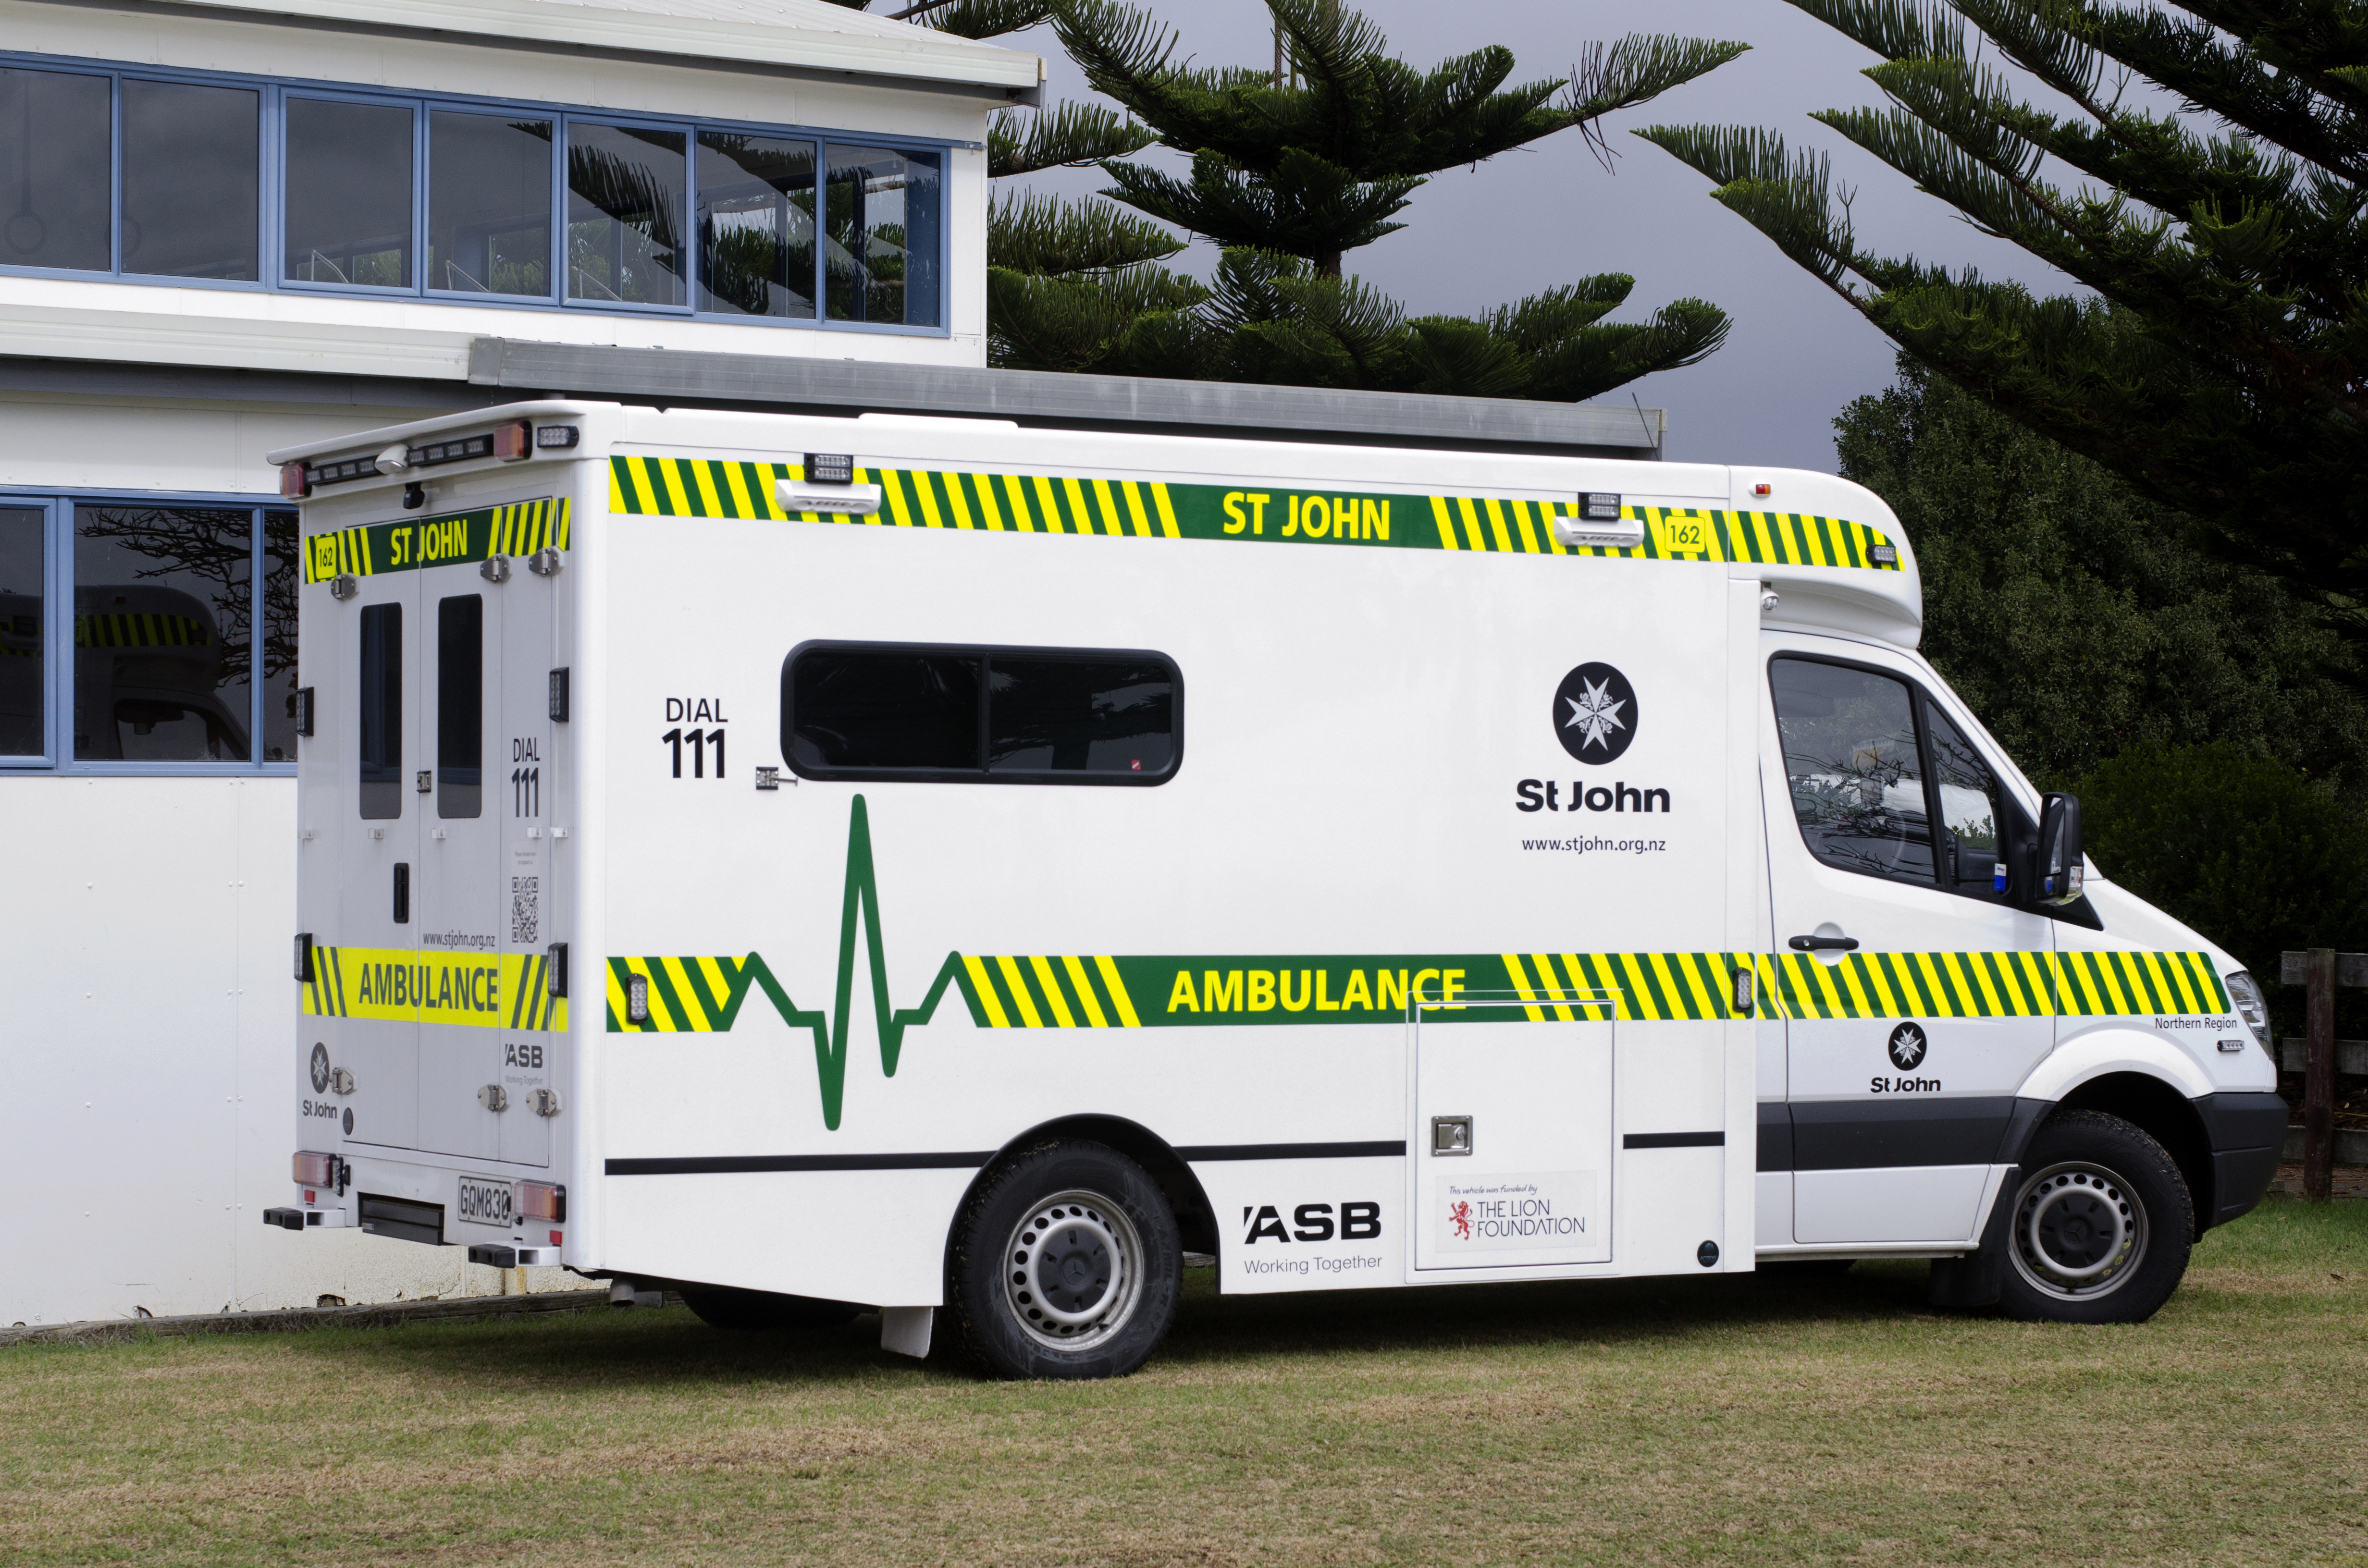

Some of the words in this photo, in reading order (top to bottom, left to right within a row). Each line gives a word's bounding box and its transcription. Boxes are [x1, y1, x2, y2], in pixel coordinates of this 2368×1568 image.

[1223, 491, 1270, 535] ST
[1282, 495, 1390, 540] JOHN
[391, 527, 412, 565] ST
[417, 519, 467, 562] JOHN
[1670, 525, 1700, 544] 162
[319, 547, 333, 567] 162
[666, 698, 728, 723] DIAL
[513, 737, 540, 762] DIAL
[662, 728, 725, 779] 111
[511, 767, 539, 818] 111
[1516, 779, 1558, 812] St
[1567, 781, 1670, 813] John
[1522, 835, 1665, 855] www.stjohn.org.nz
[423, 930, 495, 950] www.stjohn.org.nz
[358, 963, 498, 1012] AMBULANCE
[1167, 968, 1467, 1013] AMBULANCE
[2155, 1017, 2201, 1029] Northern
[2205, 1017, 2237, 1031] Region
[505, 1043, 543, 1068] ASB
[1870, 1077, 1890, 1093] St
[1894, 1077, 1941, 1092] John
[303, 1099, 312, 1116] St
[313, 1101, 337, 1119] John
[1449, 1186, 1461, 1195] This
[1462, 1185, 1485, 1194] vehicle
[1500, 1184, 1527, 1193] funded
[1528, 1184, 1538, 1195] by
[461, 1184, 509, 1221] GQM830
[1477, 1200, 1506, 1218] THE
[1511, 1199, 1550, 1217] LION
[1244, 1201, 1381, 1245] ASB
[1477, 1216, 1585, 1237] FOUNDATION
[1244, 1258, 1308, 1274] Working
[1313, 1254, 1382, 1273] Together
